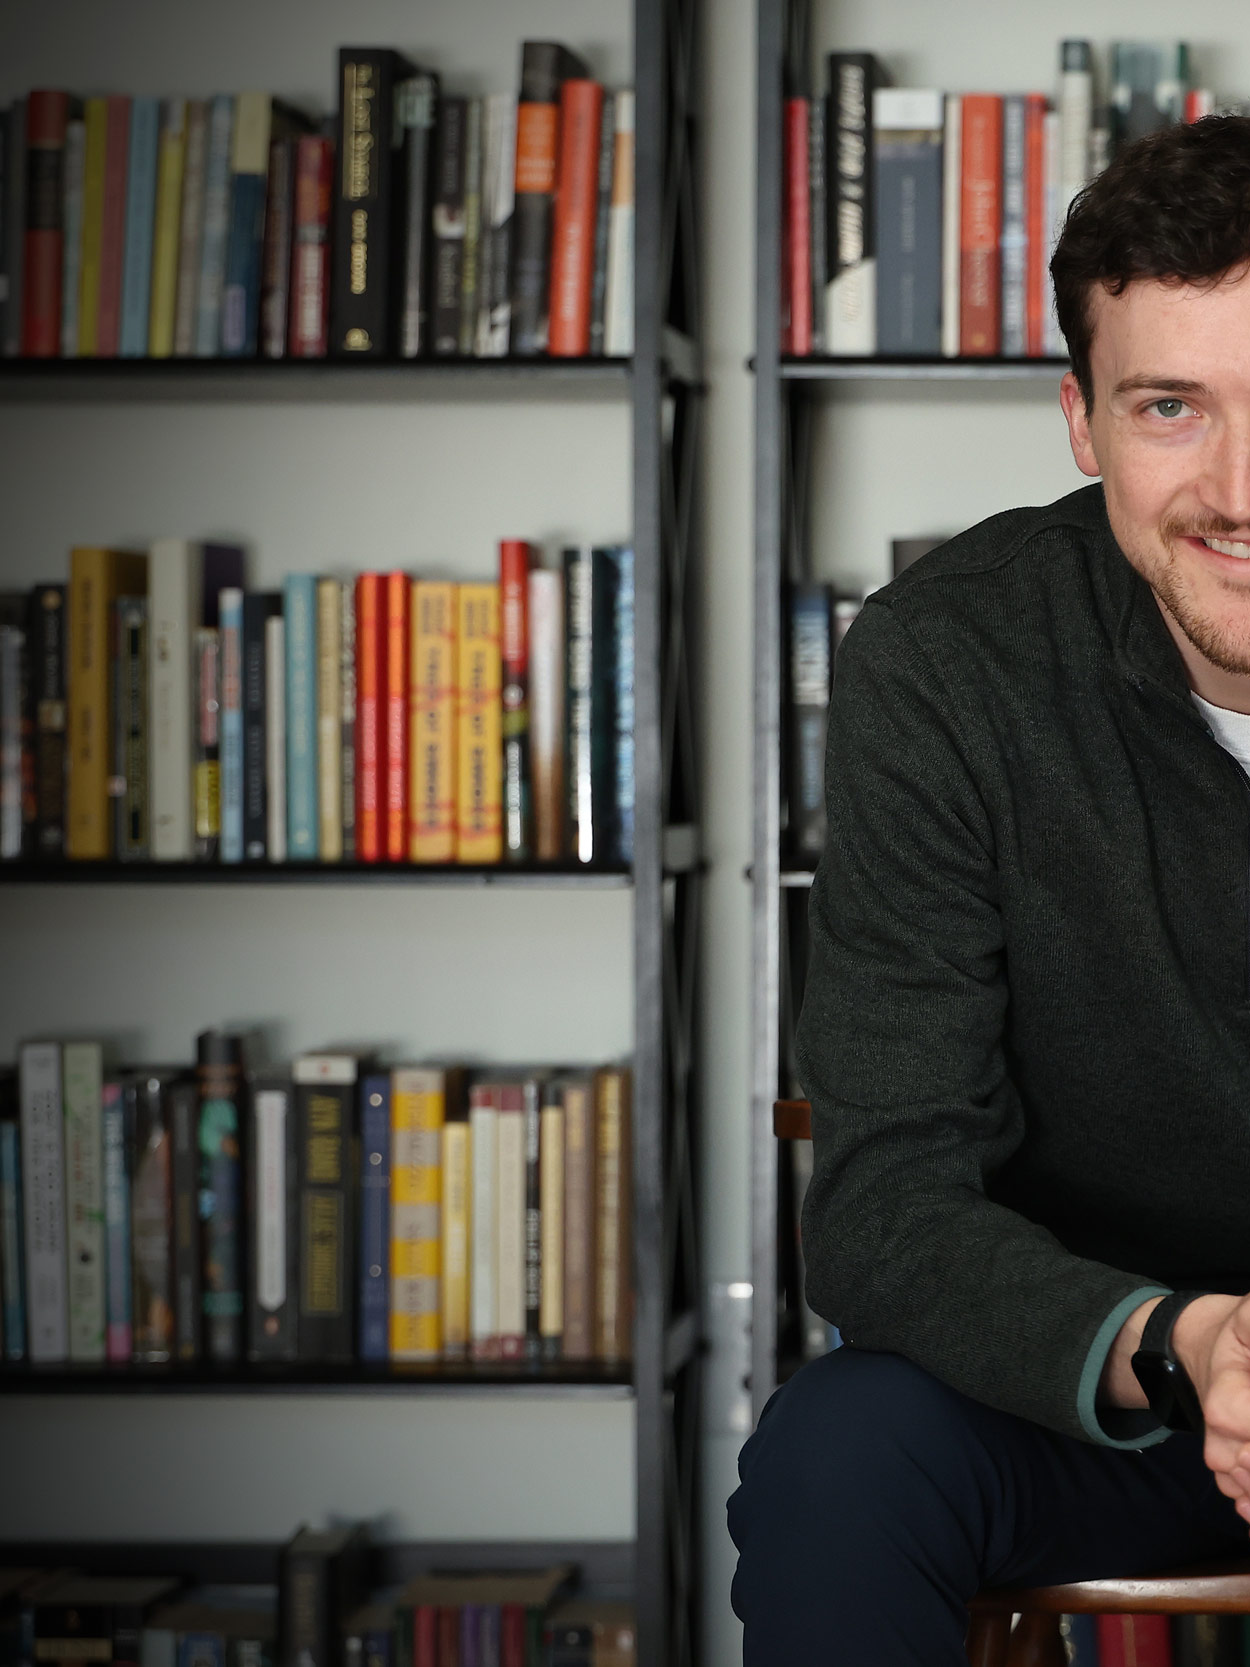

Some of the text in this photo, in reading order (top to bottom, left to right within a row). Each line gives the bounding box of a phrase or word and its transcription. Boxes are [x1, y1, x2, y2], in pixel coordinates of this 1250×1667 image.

[970, 180, 995, 225] John
[350, 208, 368, 294] DAN BROWN
[971, 226, 995, 305] Cheever
